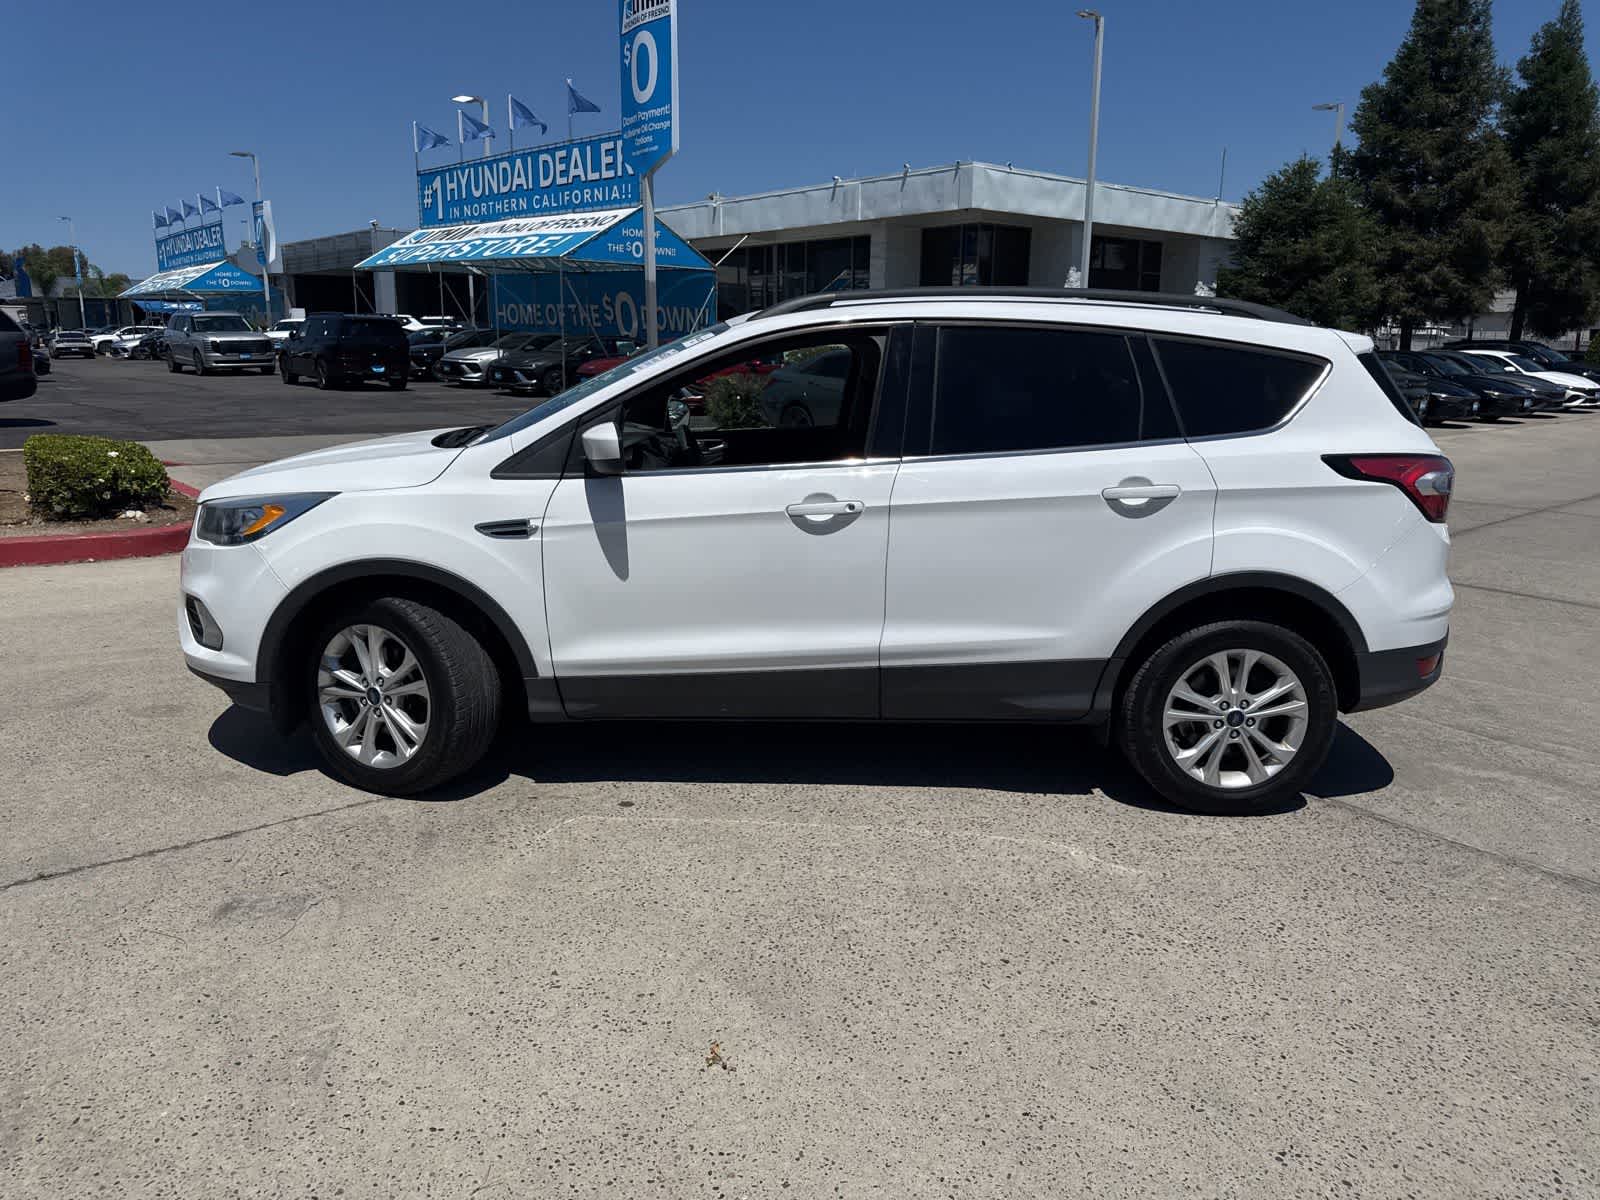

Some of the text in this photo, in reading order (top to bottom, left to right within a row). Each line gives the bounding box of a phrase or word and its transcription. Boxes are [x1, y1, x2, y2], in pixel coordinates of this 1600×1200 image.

[624, 30, 658, 104] $0
[648, 120, 671, 131] Change
[424, 175, 444, 220] #1
[446, 156, 533, 202] HYUNDAI
[450, 183, 632, 219] IN NORTHERN CALIFORNIA!!
[550, 215, 619, 229] FRESNO
[622, 228, 643, 238] HOM
[193, 226, 223, 251] DEALER
[376, 235, 574, 264] SUPERSTORE!
[608, 243, 625, 253] THE
[626, 241, 643, 258] $0
[498, 304, 544, 326] HOME
[545, 304, 565, 327] OF
[568, 304, 601, 328] THE
[602, 291, 639, 338] $0
